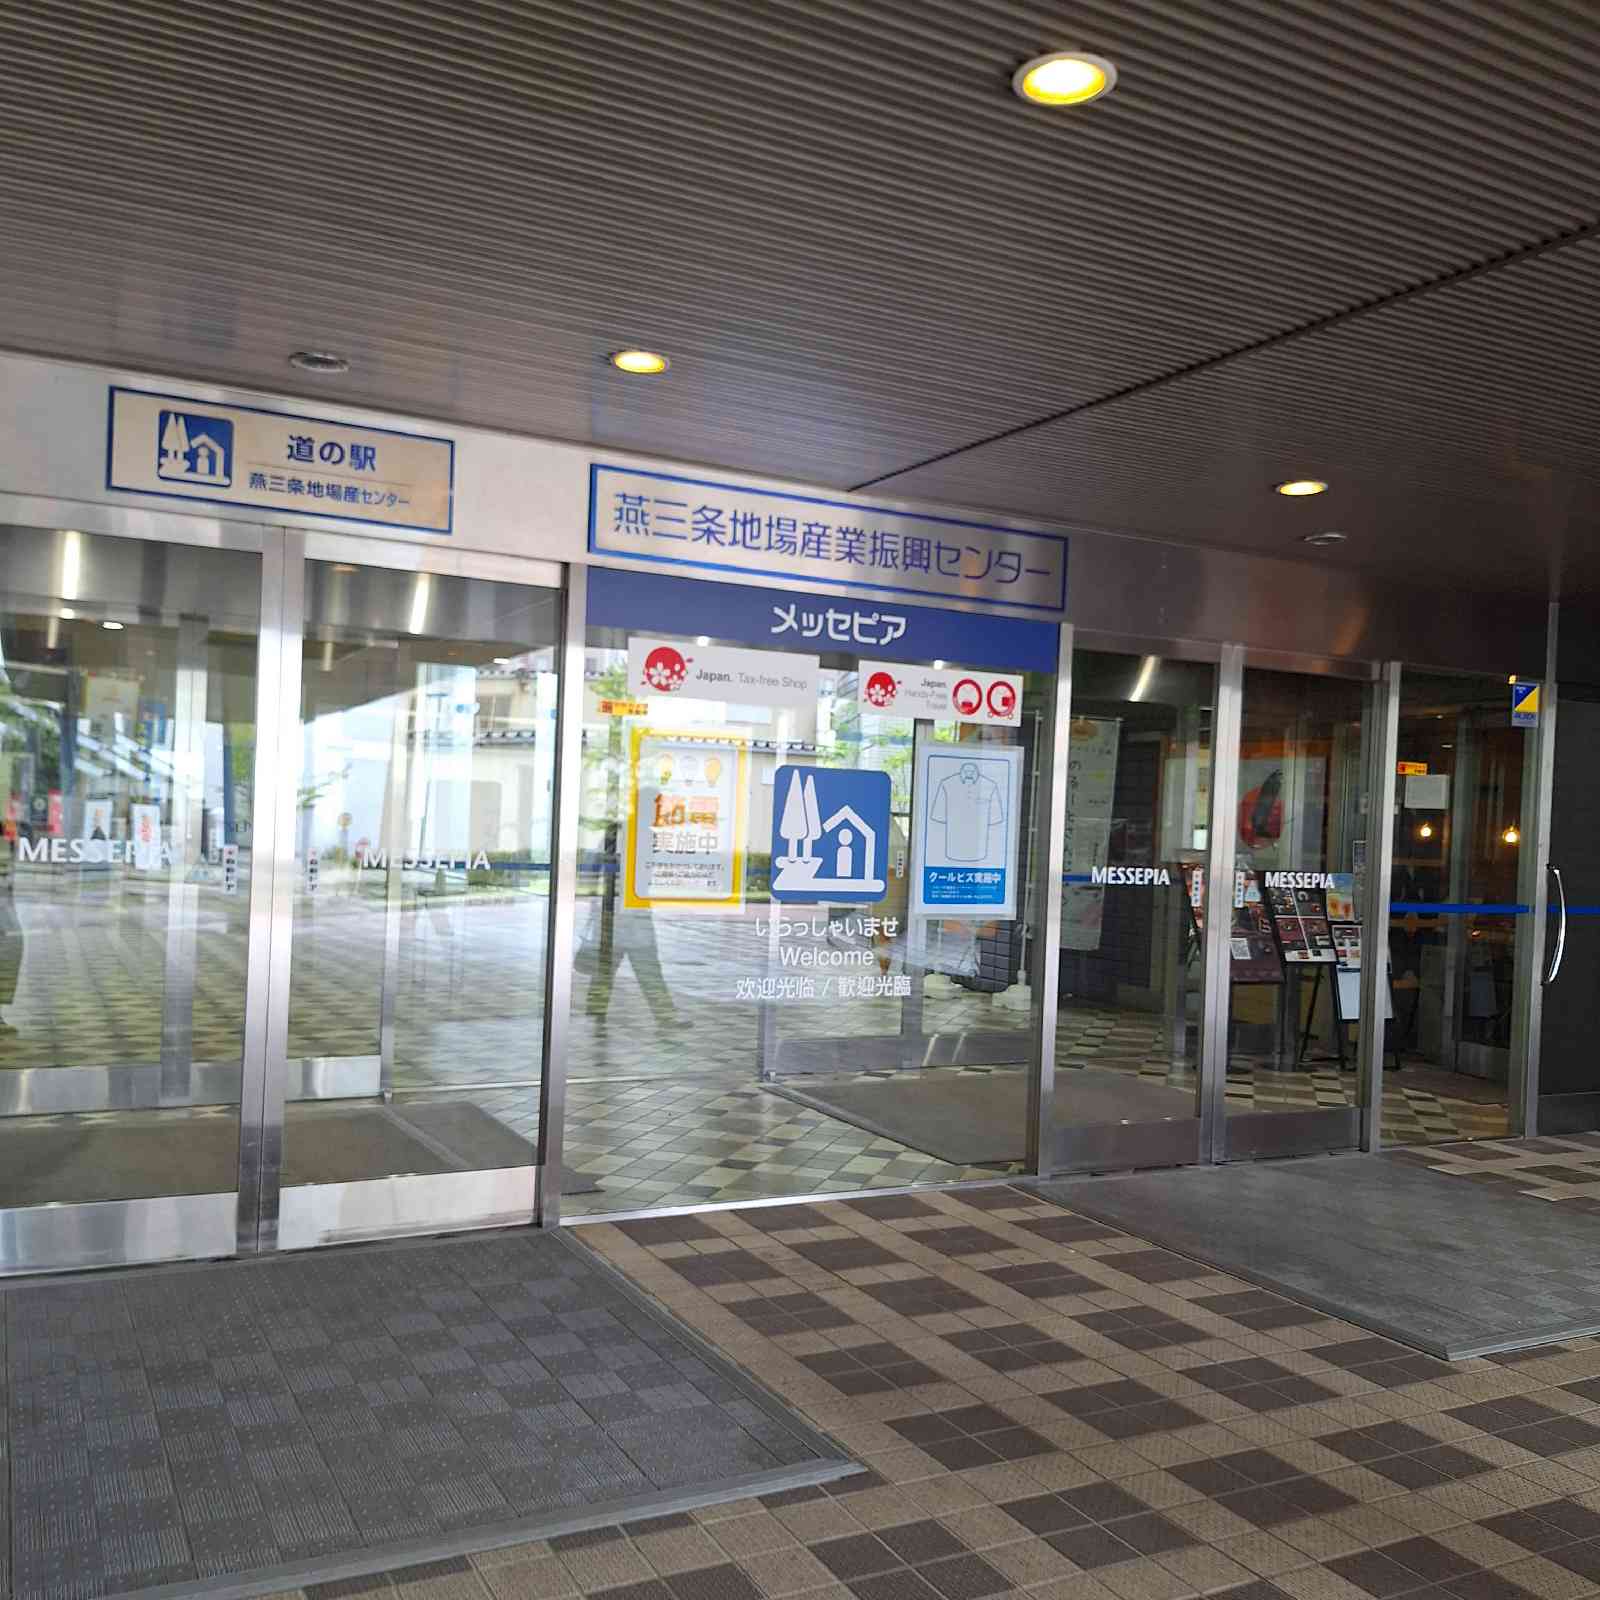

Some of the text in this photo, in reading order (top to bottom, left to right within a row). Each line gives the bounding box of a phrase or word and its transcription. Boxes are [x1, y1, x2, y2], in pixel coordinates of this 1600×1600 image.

[287, 435, 377, 472] 道の駅
[249, 472, 411, 508] 燕三条地場産センター
[614, 491, 1051, 584] 燕三条地場産業振興センター
[771, 603, 907, 646] メッセピア
[738, 672, 779, 687] Tax-free
[781, 676, 807, 689] Shop
[1091, 866, 1170, 885] MESSEPIA
[1265, 872, 1336, 889] MESSEPIA
[780, 948, 874, 967] Welcome
[736, 976, 815, 1000] 欢迎光临
